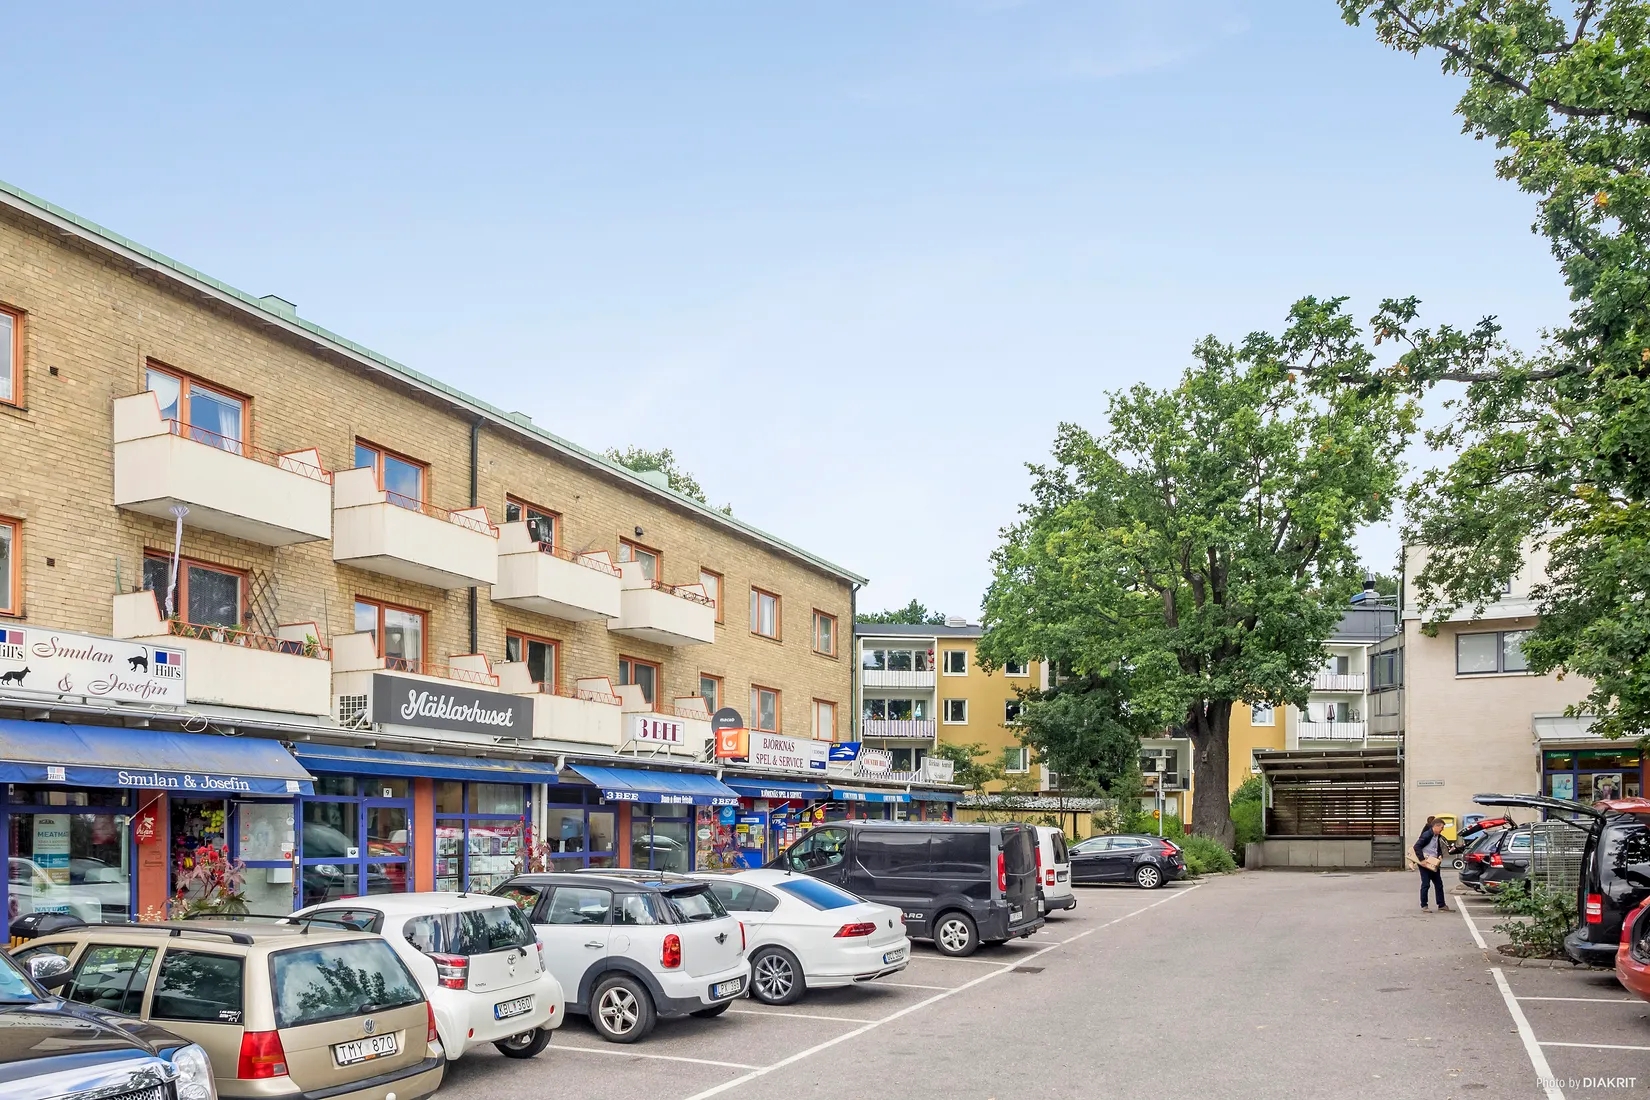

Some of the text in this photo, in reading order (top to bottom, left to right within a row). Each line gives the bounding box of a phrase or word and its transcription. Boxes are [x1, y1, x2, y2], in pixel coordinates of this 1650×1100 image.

[0, 644, 24, 659] ill's
[32, 636, 114, 664] Smulan
[155, 664, 182, 678] Hill's
[57, 672, 168, 699] & Josefin
[401, 689, 514, 728] Mäklarhuset
[639, 718, 681, 743] 3 BEE
[763, 736, 795, 753] BJÖRKNÄS
[755, 753, 772, 766] SPEL
[772, 755, 778, 766] &
[778, 756, 804, 769] SERVICE
[118, 771, 250, 791] Smulan & Josefin
[606, 791, 640, 801] 3 BEE
[711, 797, 739, 806] 3 BEE
[499, 998, 531, 1016] KBL 360
[339, 1041, 363, 1060] TMY
[371, 1036, 394, 1052] 870
